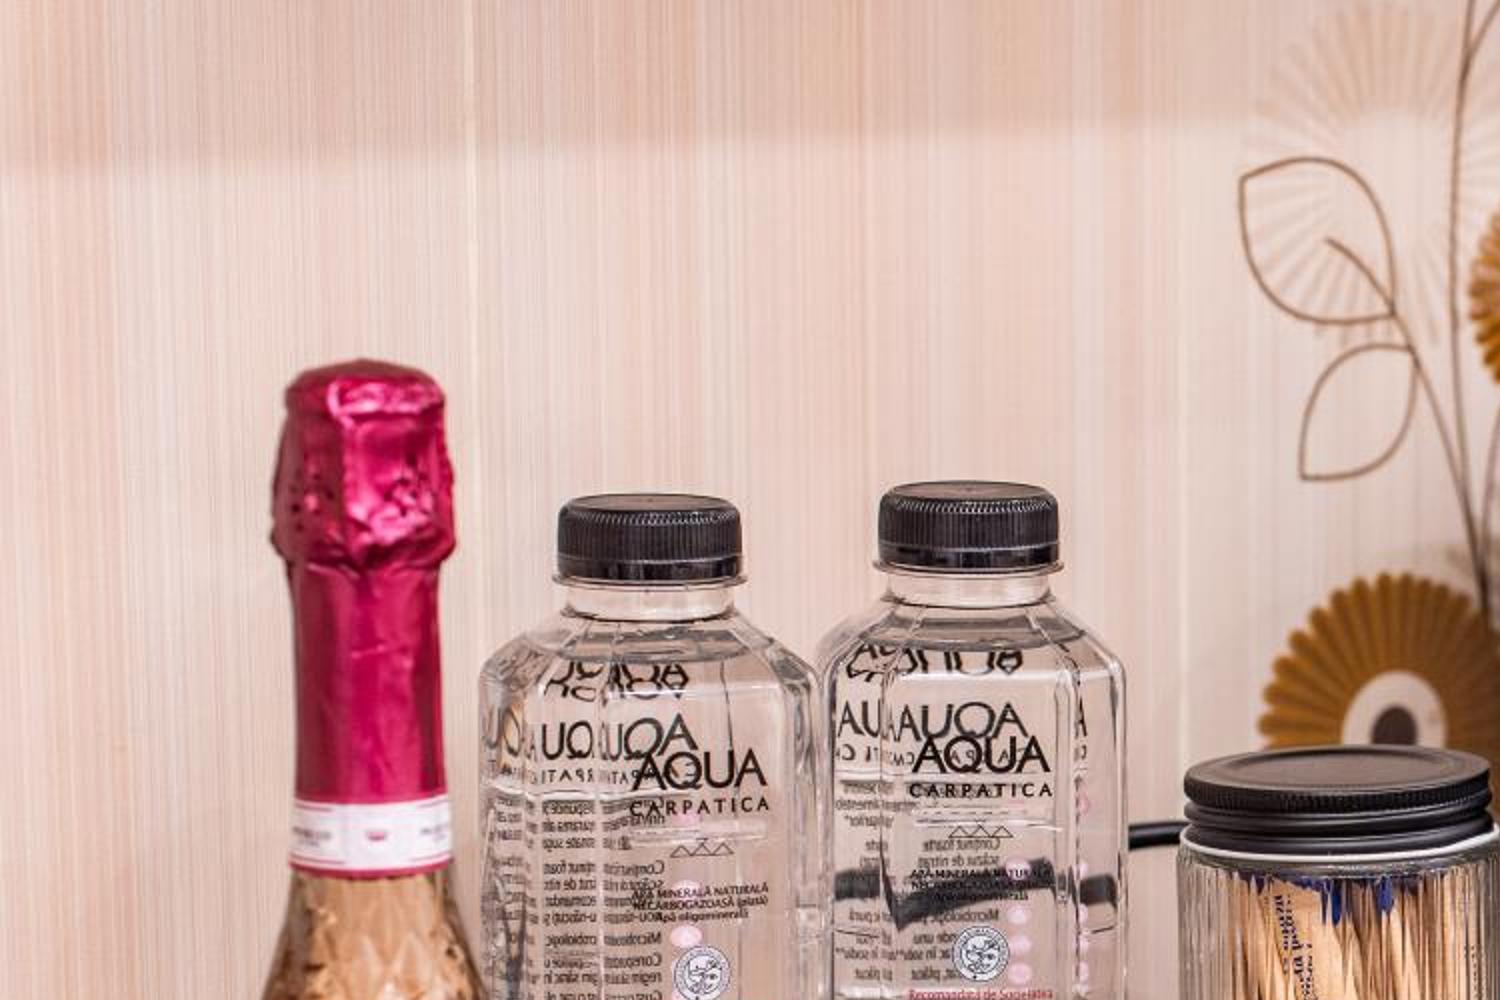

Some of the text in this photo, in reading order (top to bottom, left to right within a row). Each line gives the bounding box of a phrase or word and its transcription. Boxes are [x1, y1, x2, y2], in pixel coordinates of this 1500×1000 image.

[632, 748, 768, 791] AQUA
[911, 735, 1051, 774] AQUA
[909, 783, 1053, 798] CARPATICA
[629, 796, 770, 817] CARPATICA
